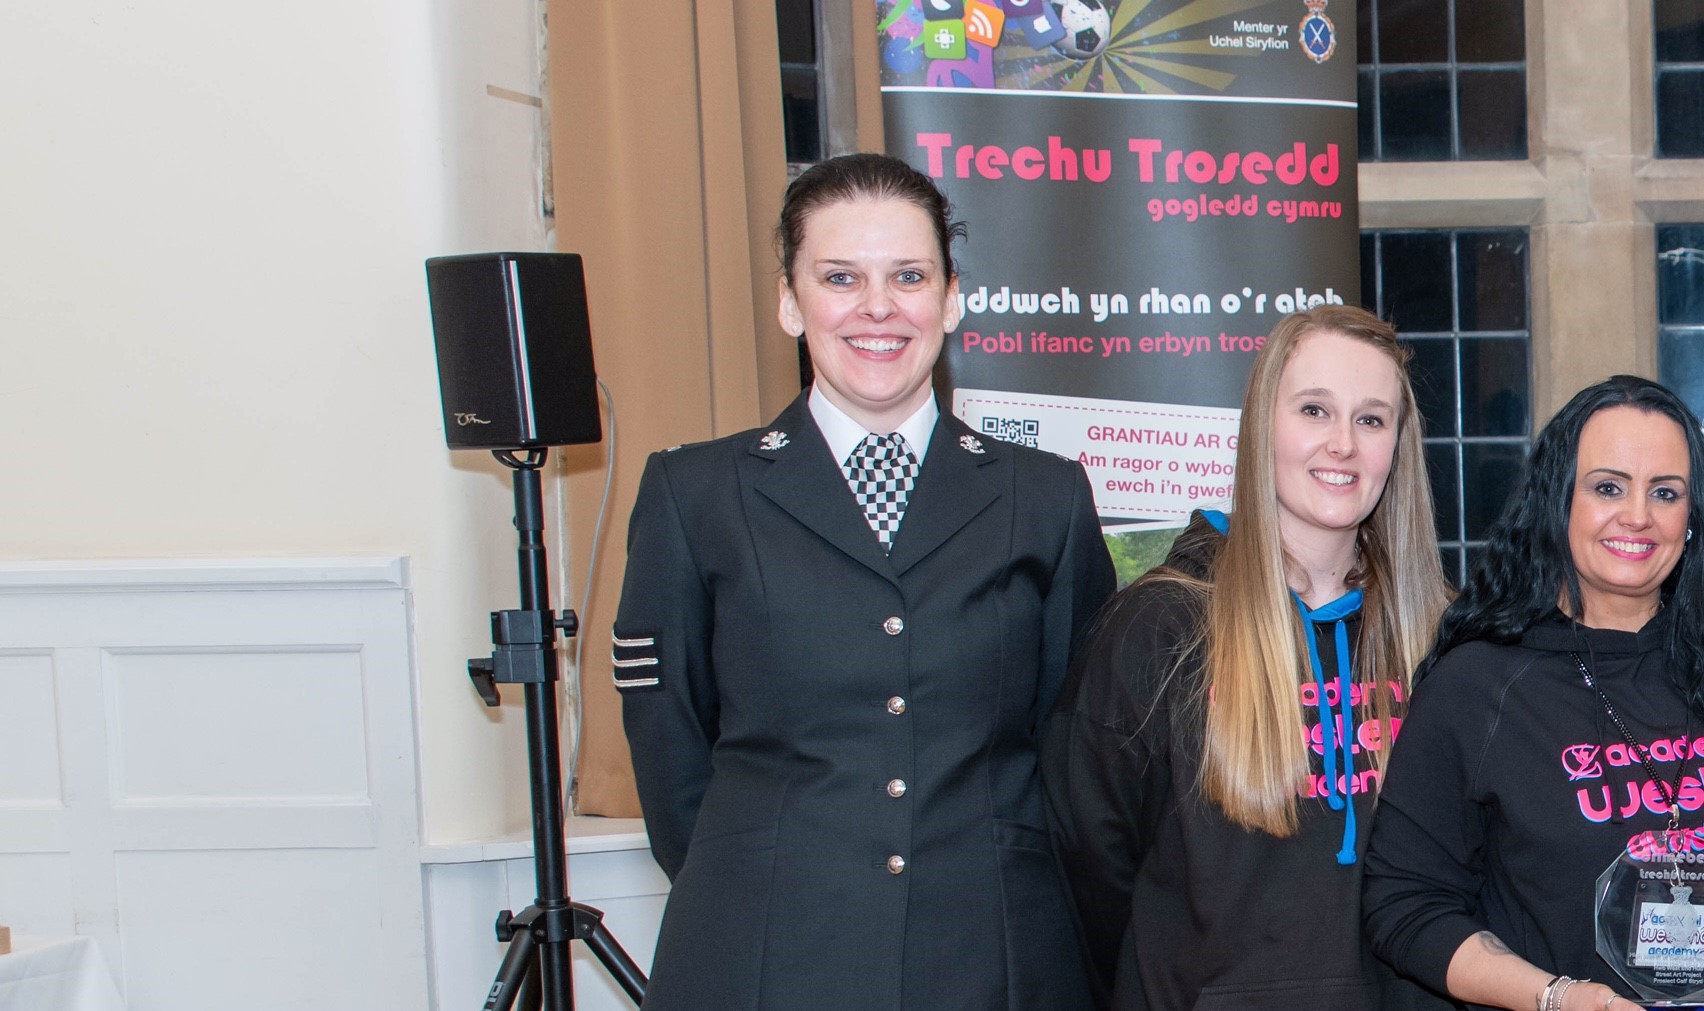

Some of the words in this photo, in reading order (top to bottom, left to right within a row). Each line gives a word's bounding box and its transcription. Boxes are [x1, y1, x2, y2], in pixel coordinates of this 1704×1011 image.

[1233, 20, 1274, 34] Menter
[1277, 24, 1288, 37] yr
[1209, 34, 1243, 48] Uchel
[1246, 36, 1289, 51] Siryfion
[916, 133, 1112, 182] Trechu
[1129, 138, 1339, 187] Trosedd
[1147, 193, 1259, 223] gogledd
[1266, 199, 1342, 224] cymru
[1090, 293, 1129, 322] yn
[1140, 287, 1211, 314] rhan
[1220, 286, 1267, 314] o'r
[962, 331, 1022, 353] Pobl
[1031, 331, 1094, 353] ifanc
[1101, 335, 1131, 358] yn
[1139, 331, 1211, 357] erbyn
[1087, 425, 1188, 447] GRANTIAU
[1193, 433, 1221, 449] AR
[1078, 451, 1107, 468] Am
[1112, 456, 1163, 473] ragor
[1168, 461, 1180, 472] o
[1106, 478, 1155, 494] ewch
[1161, 479, 1182, 495] i'n
